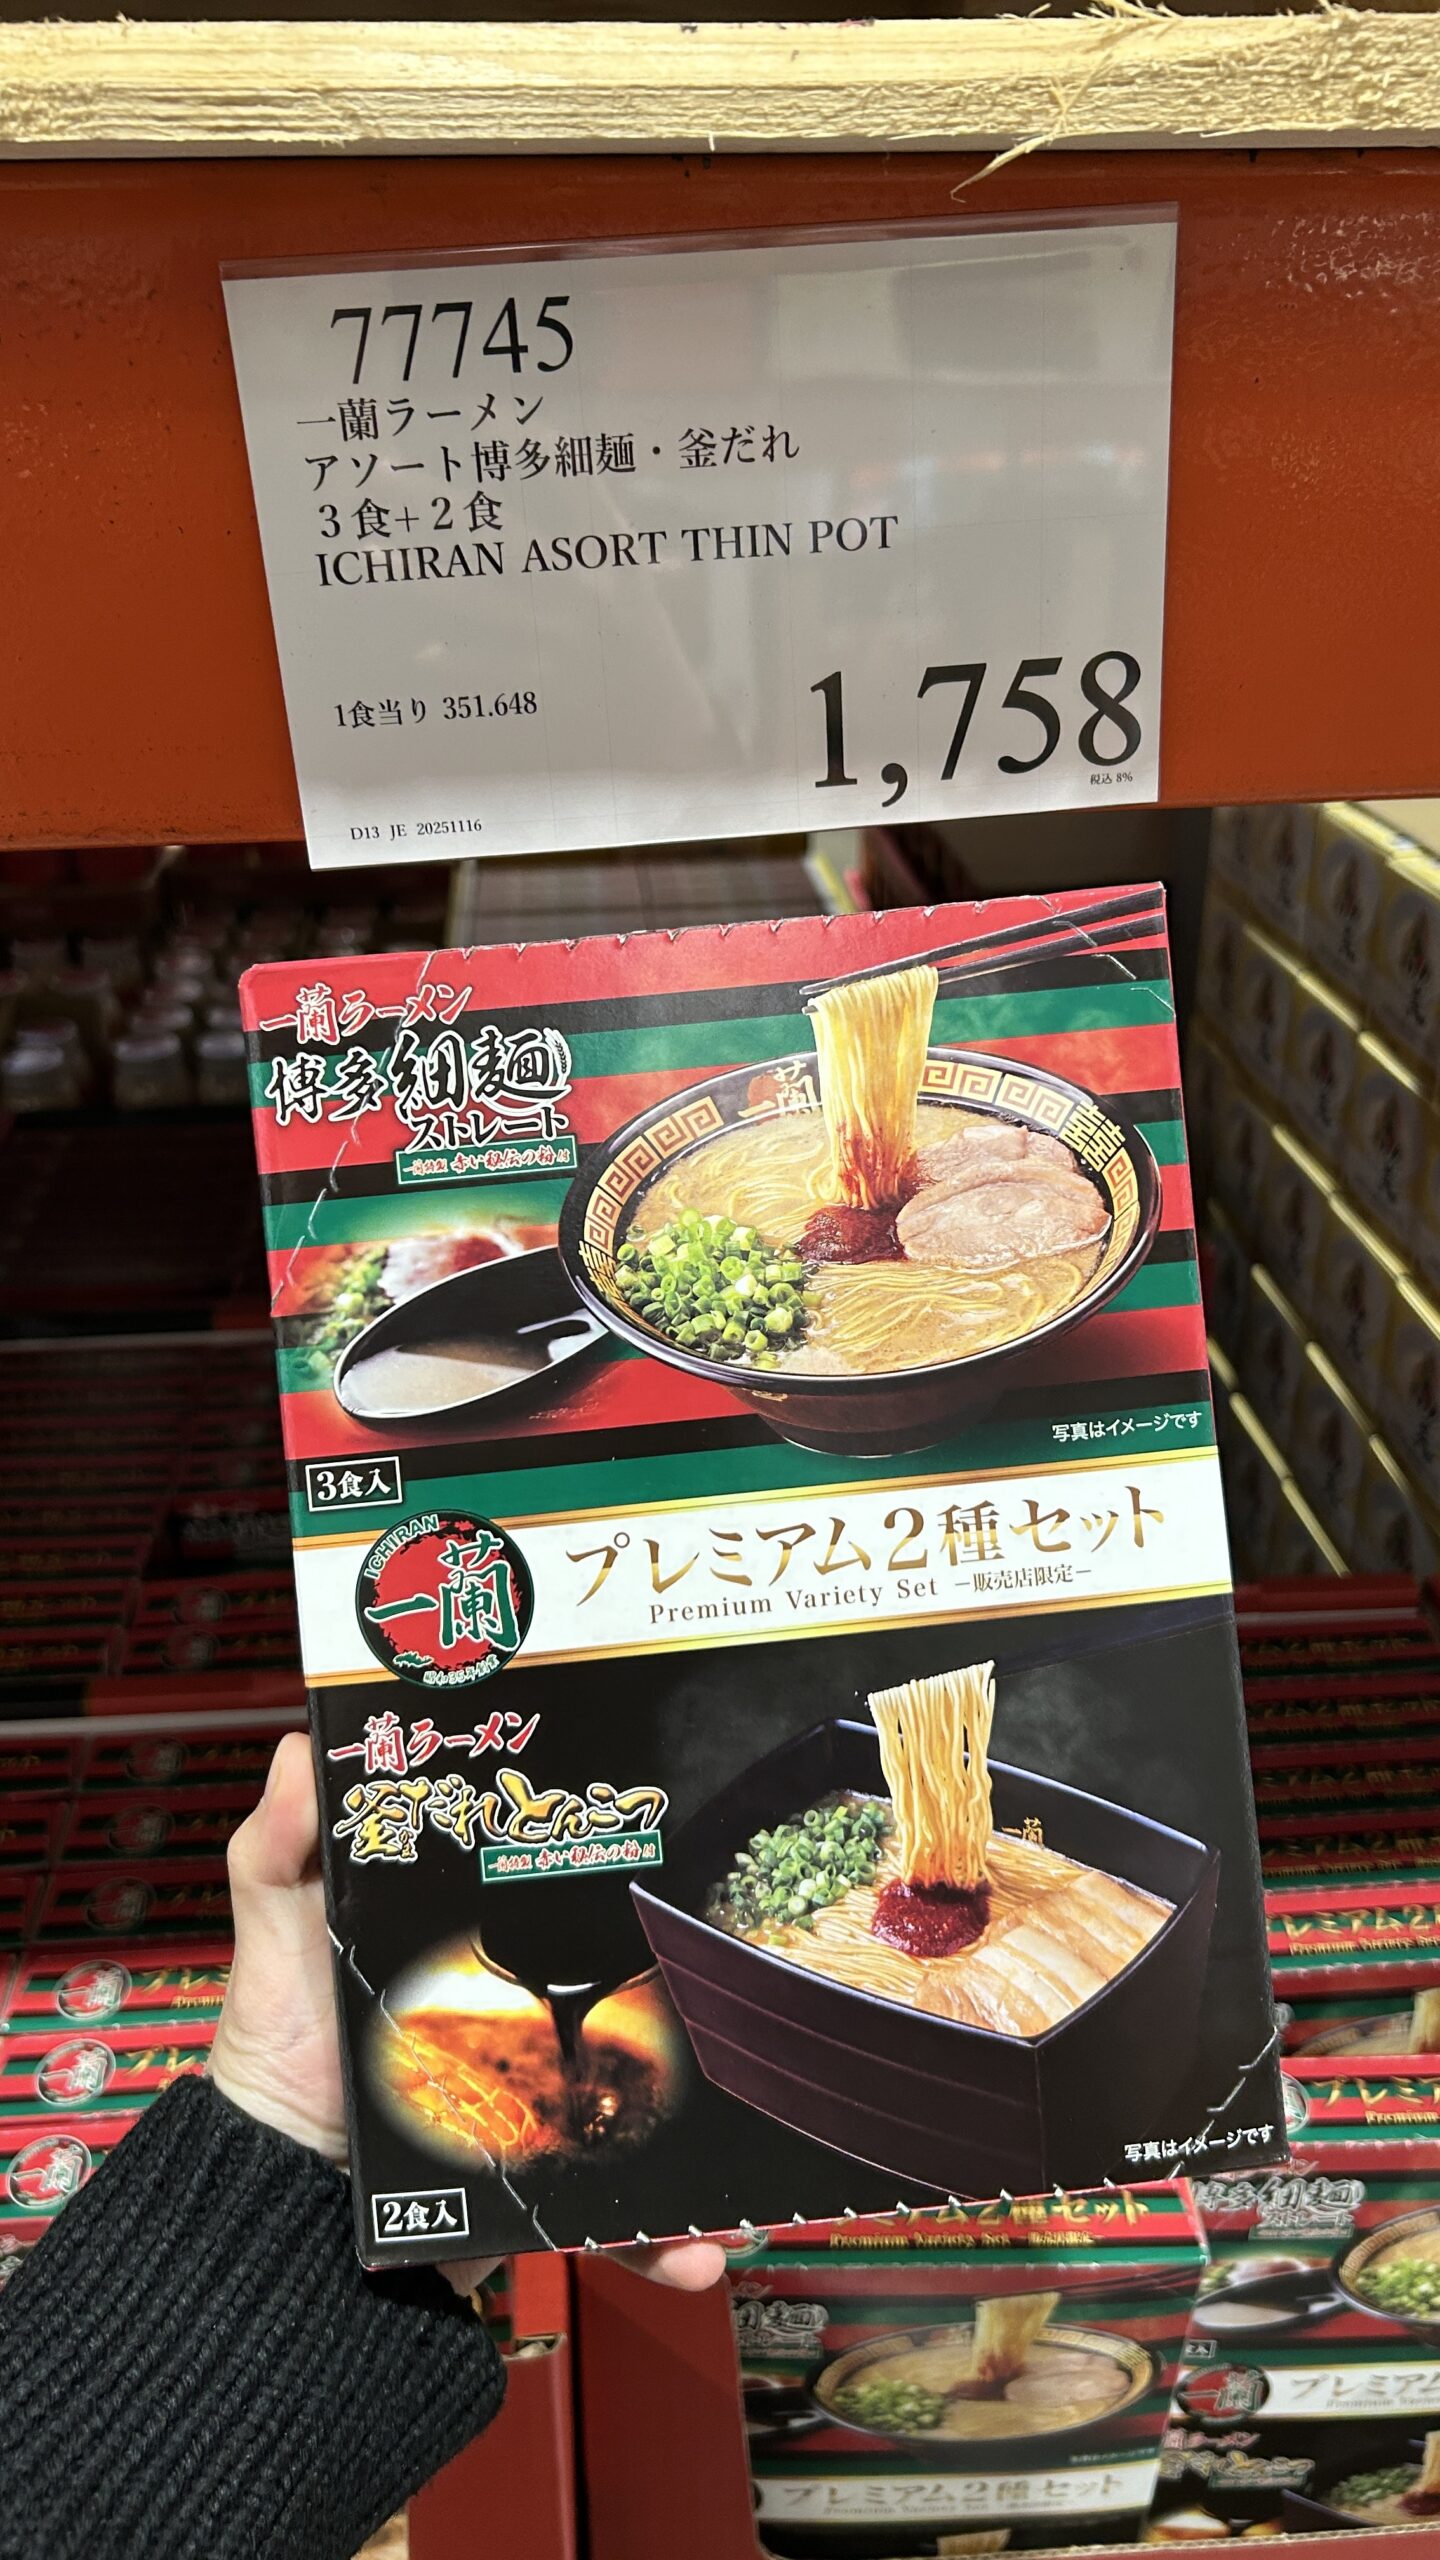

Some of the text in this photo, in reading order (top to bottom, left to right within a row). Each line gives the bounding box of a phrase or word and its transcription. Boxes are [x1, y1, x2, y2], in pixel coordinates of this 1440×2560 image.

[329, 295, 574, 385] 77745
[296, 392, 544, 442] 一蘭ラーメン
[303, 424, 800, 492] アソート博多細麺・釜だれ
[316, 515, 898, 587] ICHIRAN ASORT THIN POT
[334, 691, 538, 729] 1食当り 351.648
[810, 650, 1142, 808] 1,758
[1116, 771, 1134, 783] 8%
[350, 818, 482, 841] D13 JE 20251116
[259, 982, 473, 1046] 一蘭ラーメン
[264, 1024, 572, 1127] 博多細麺
[404, 1104, 570, 1154] ストレート
[1051, 1410, 1202, 1443] 写真はイメージです
[315, 1466, 393, 1502] 3食入
[363, 1512, 439, 1581] ICHIRAN
[565, 1485, 1165, 1607] プレミアム2種セット
[364, 1530, 521, 1651] 一蘭
[649, 1596, 772, 1625] Premium
[786, 1583, 883, 1610] Variety
[896, 1577, 940, 1600] Set
[328, 1710, 541, 1776] 一蘭ラーメン
[333, 1767, 669, 1864] 釜だれとんこつ
[1123, 2122, 1275, 2163] 写真はイメージです
[382, 2199, 458, 2233] 2食入
